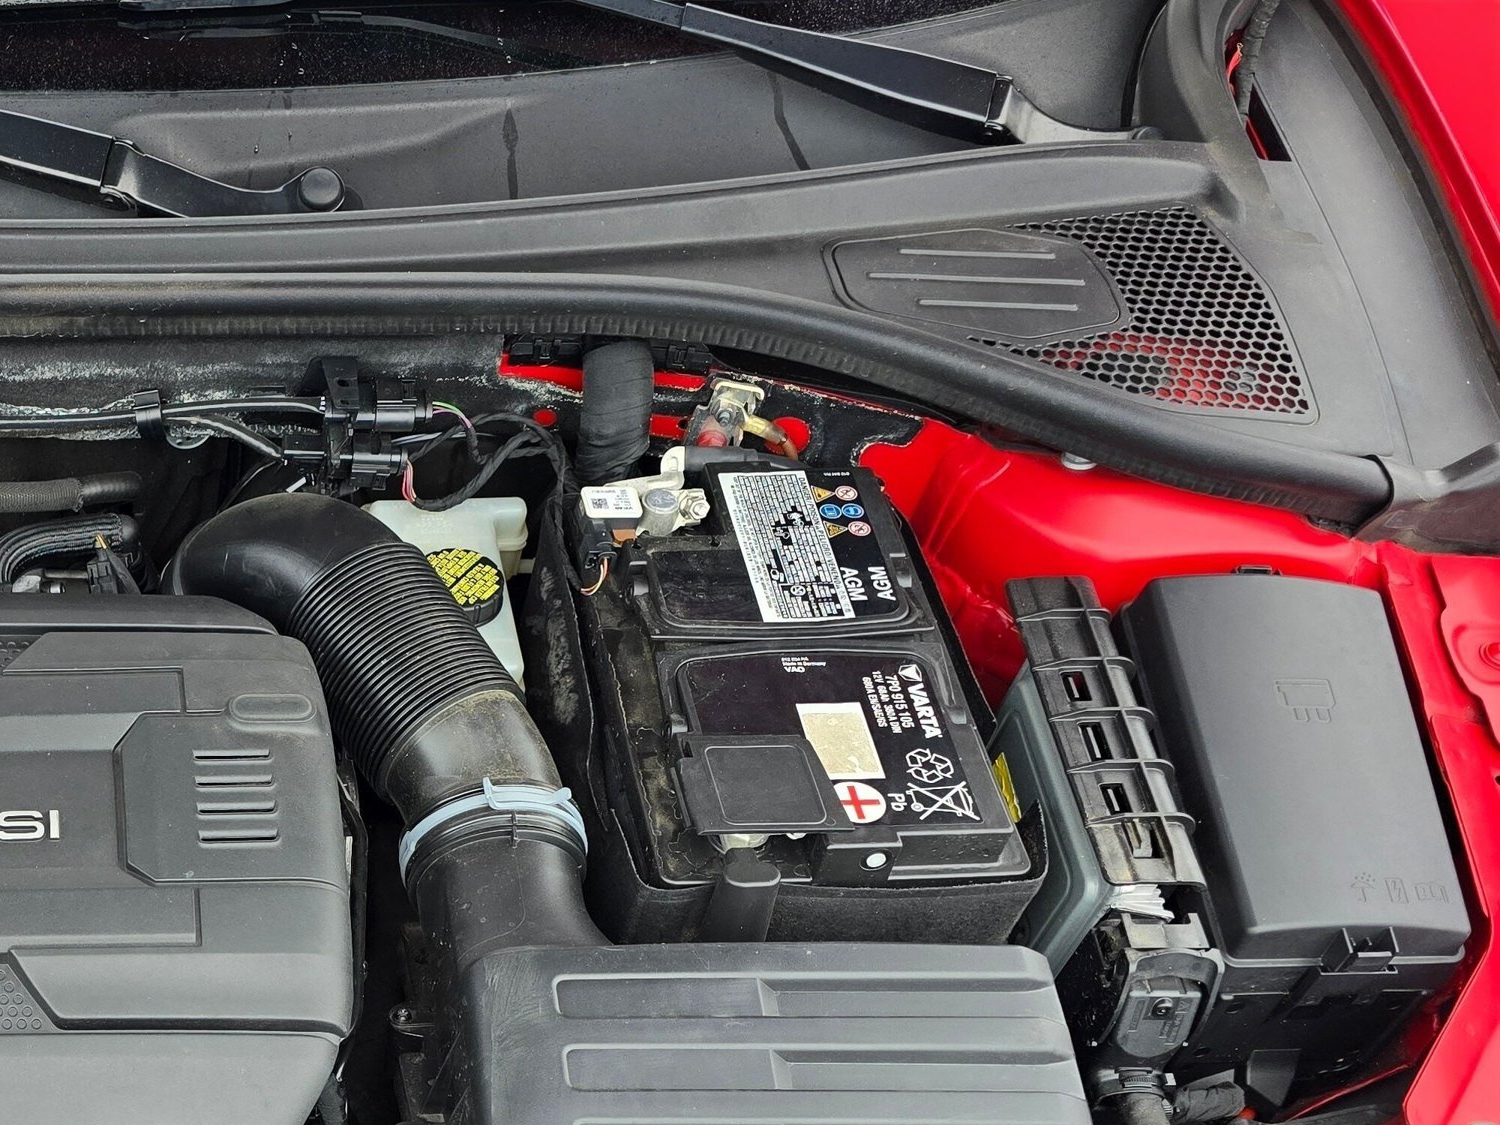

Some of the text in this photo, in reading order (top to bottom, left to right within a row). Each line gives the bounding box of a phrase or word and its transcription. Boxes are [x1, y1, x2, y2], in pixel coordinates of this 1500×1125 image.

[839, 566, 868, 602] AGM
[867, 565, 897, 602] AGM
[871, 670, 884, 682] 12V
[884, 674, 914, 728] 7P0 915 105
[905, 683, 943, 738] VARTA
[887, 792, 908, 812] Pb
